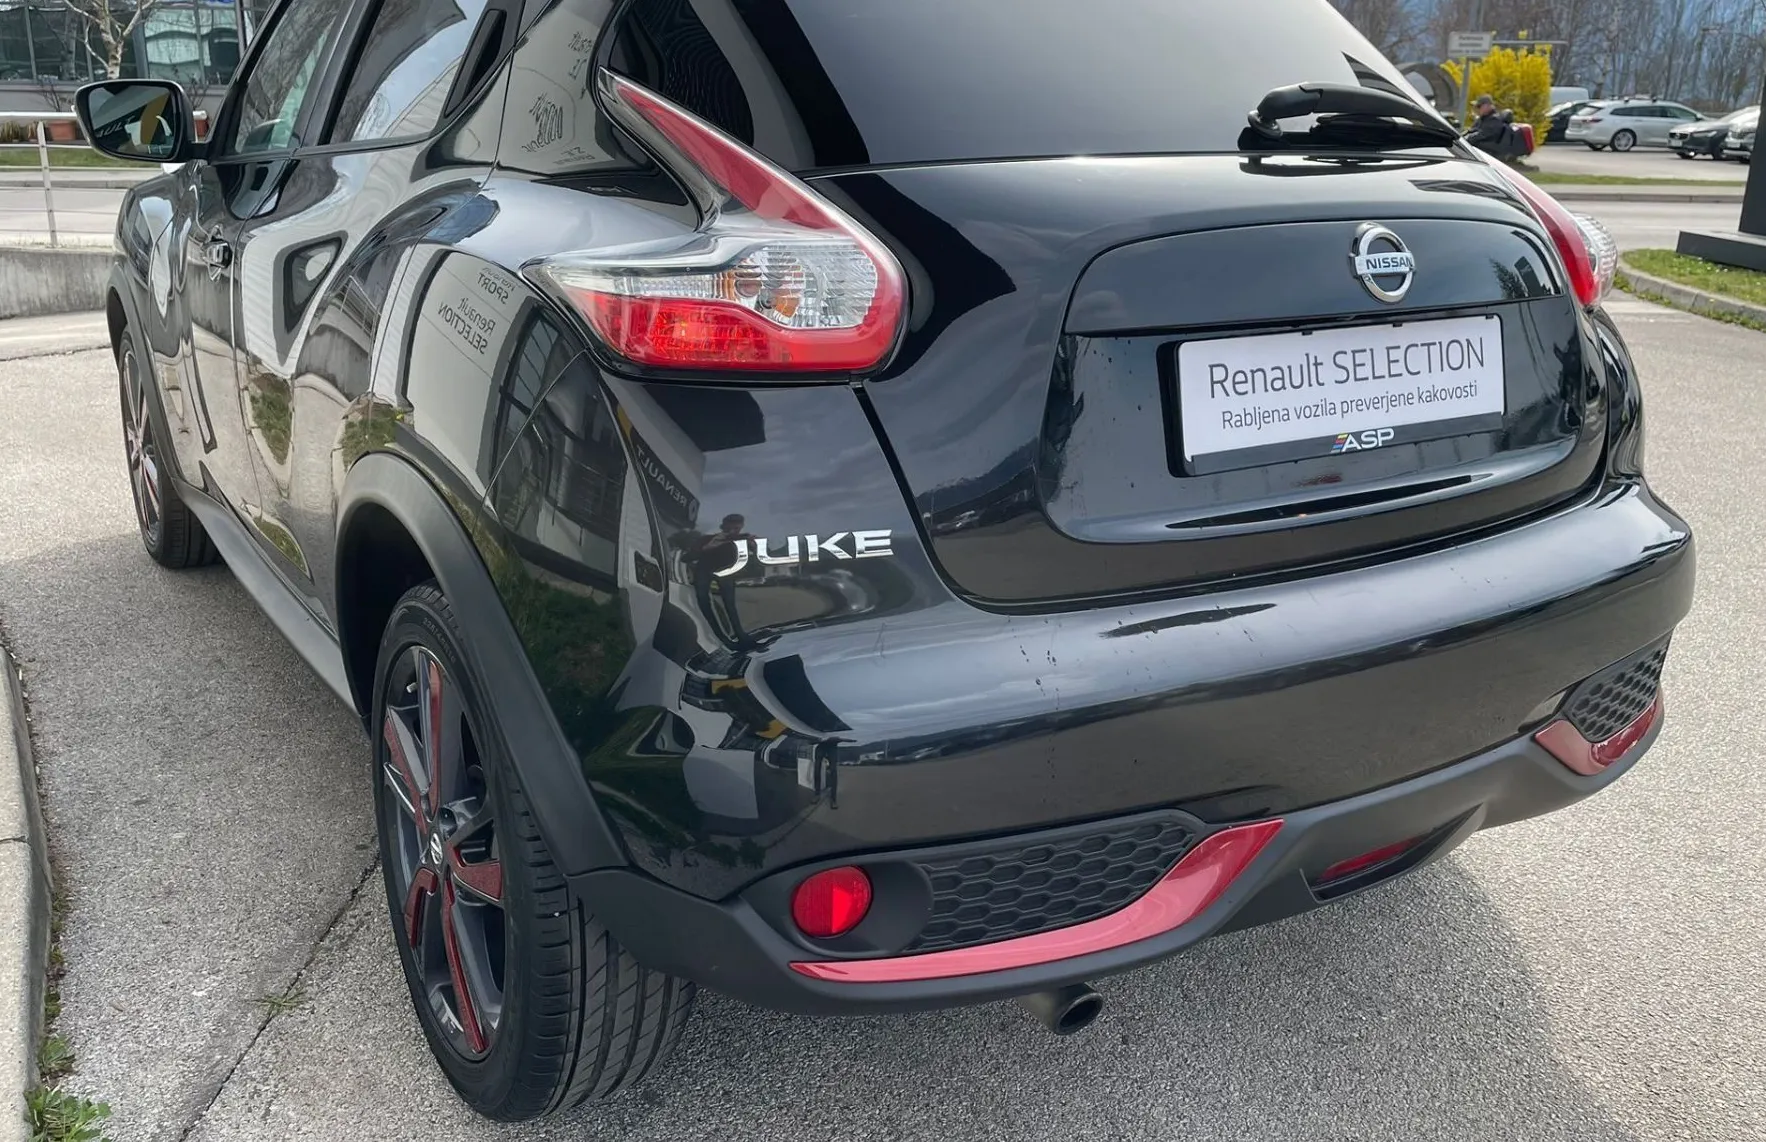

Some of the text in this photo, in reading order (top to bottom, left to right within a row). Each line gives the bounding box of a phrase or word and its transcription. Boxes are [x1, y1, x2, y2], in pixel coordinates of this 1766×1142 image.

[1366, 256, 1412, 270] NISSAN
[1208, 336, 1484, 399] Renault SELECTION
[1221, 380, 1478, 431] Rabljena vozila preverjene kakovosti
[1341, 427, 1395, 452] ASP
[712, 529, 894, 578] JUKE
